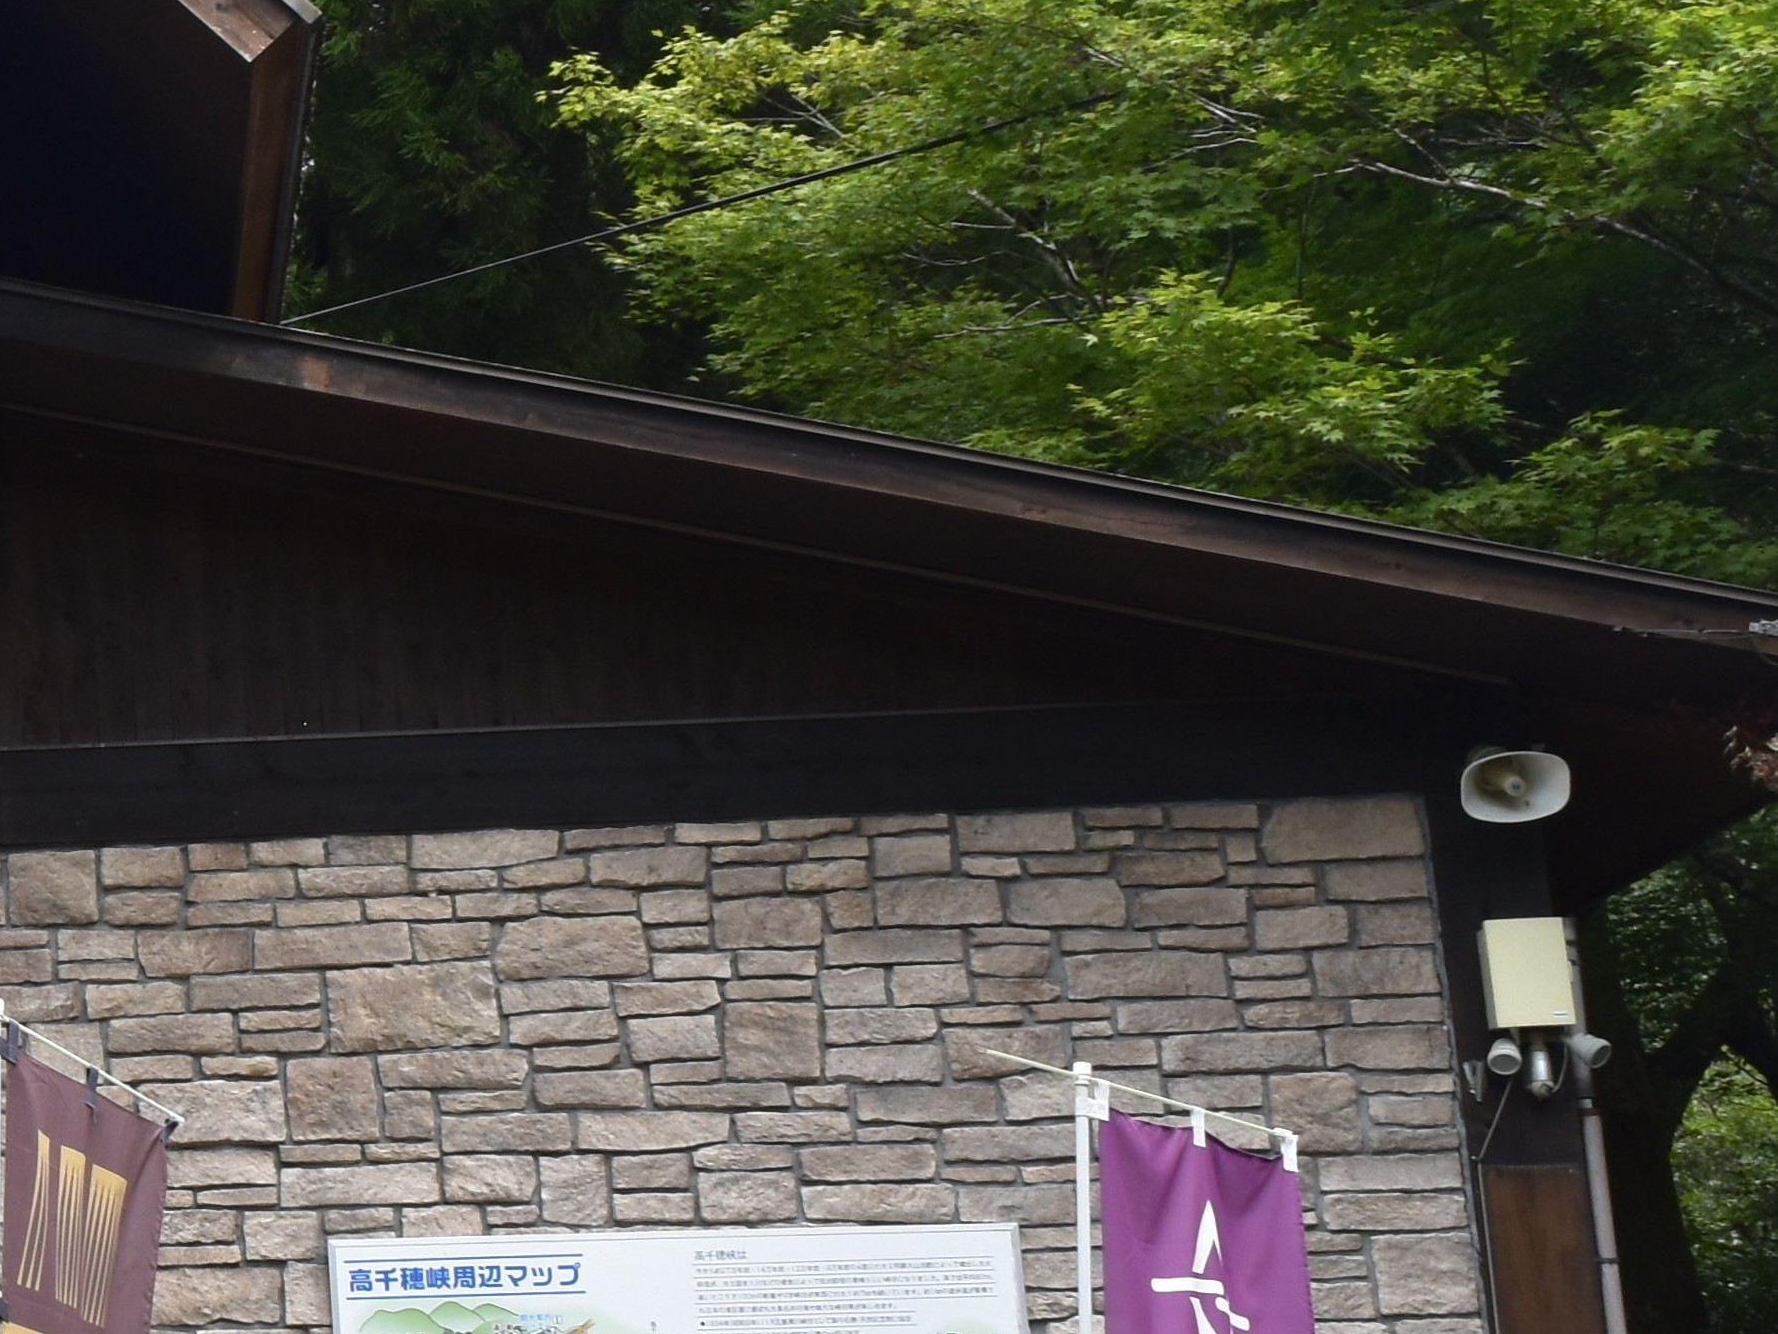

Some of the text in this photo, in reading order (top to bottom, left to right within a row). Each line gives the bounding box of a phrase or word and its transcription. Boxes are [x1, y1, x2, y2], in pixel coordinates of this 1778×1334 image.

[348, 1261, 581, 1293] 高千穂峡周辺マップ
